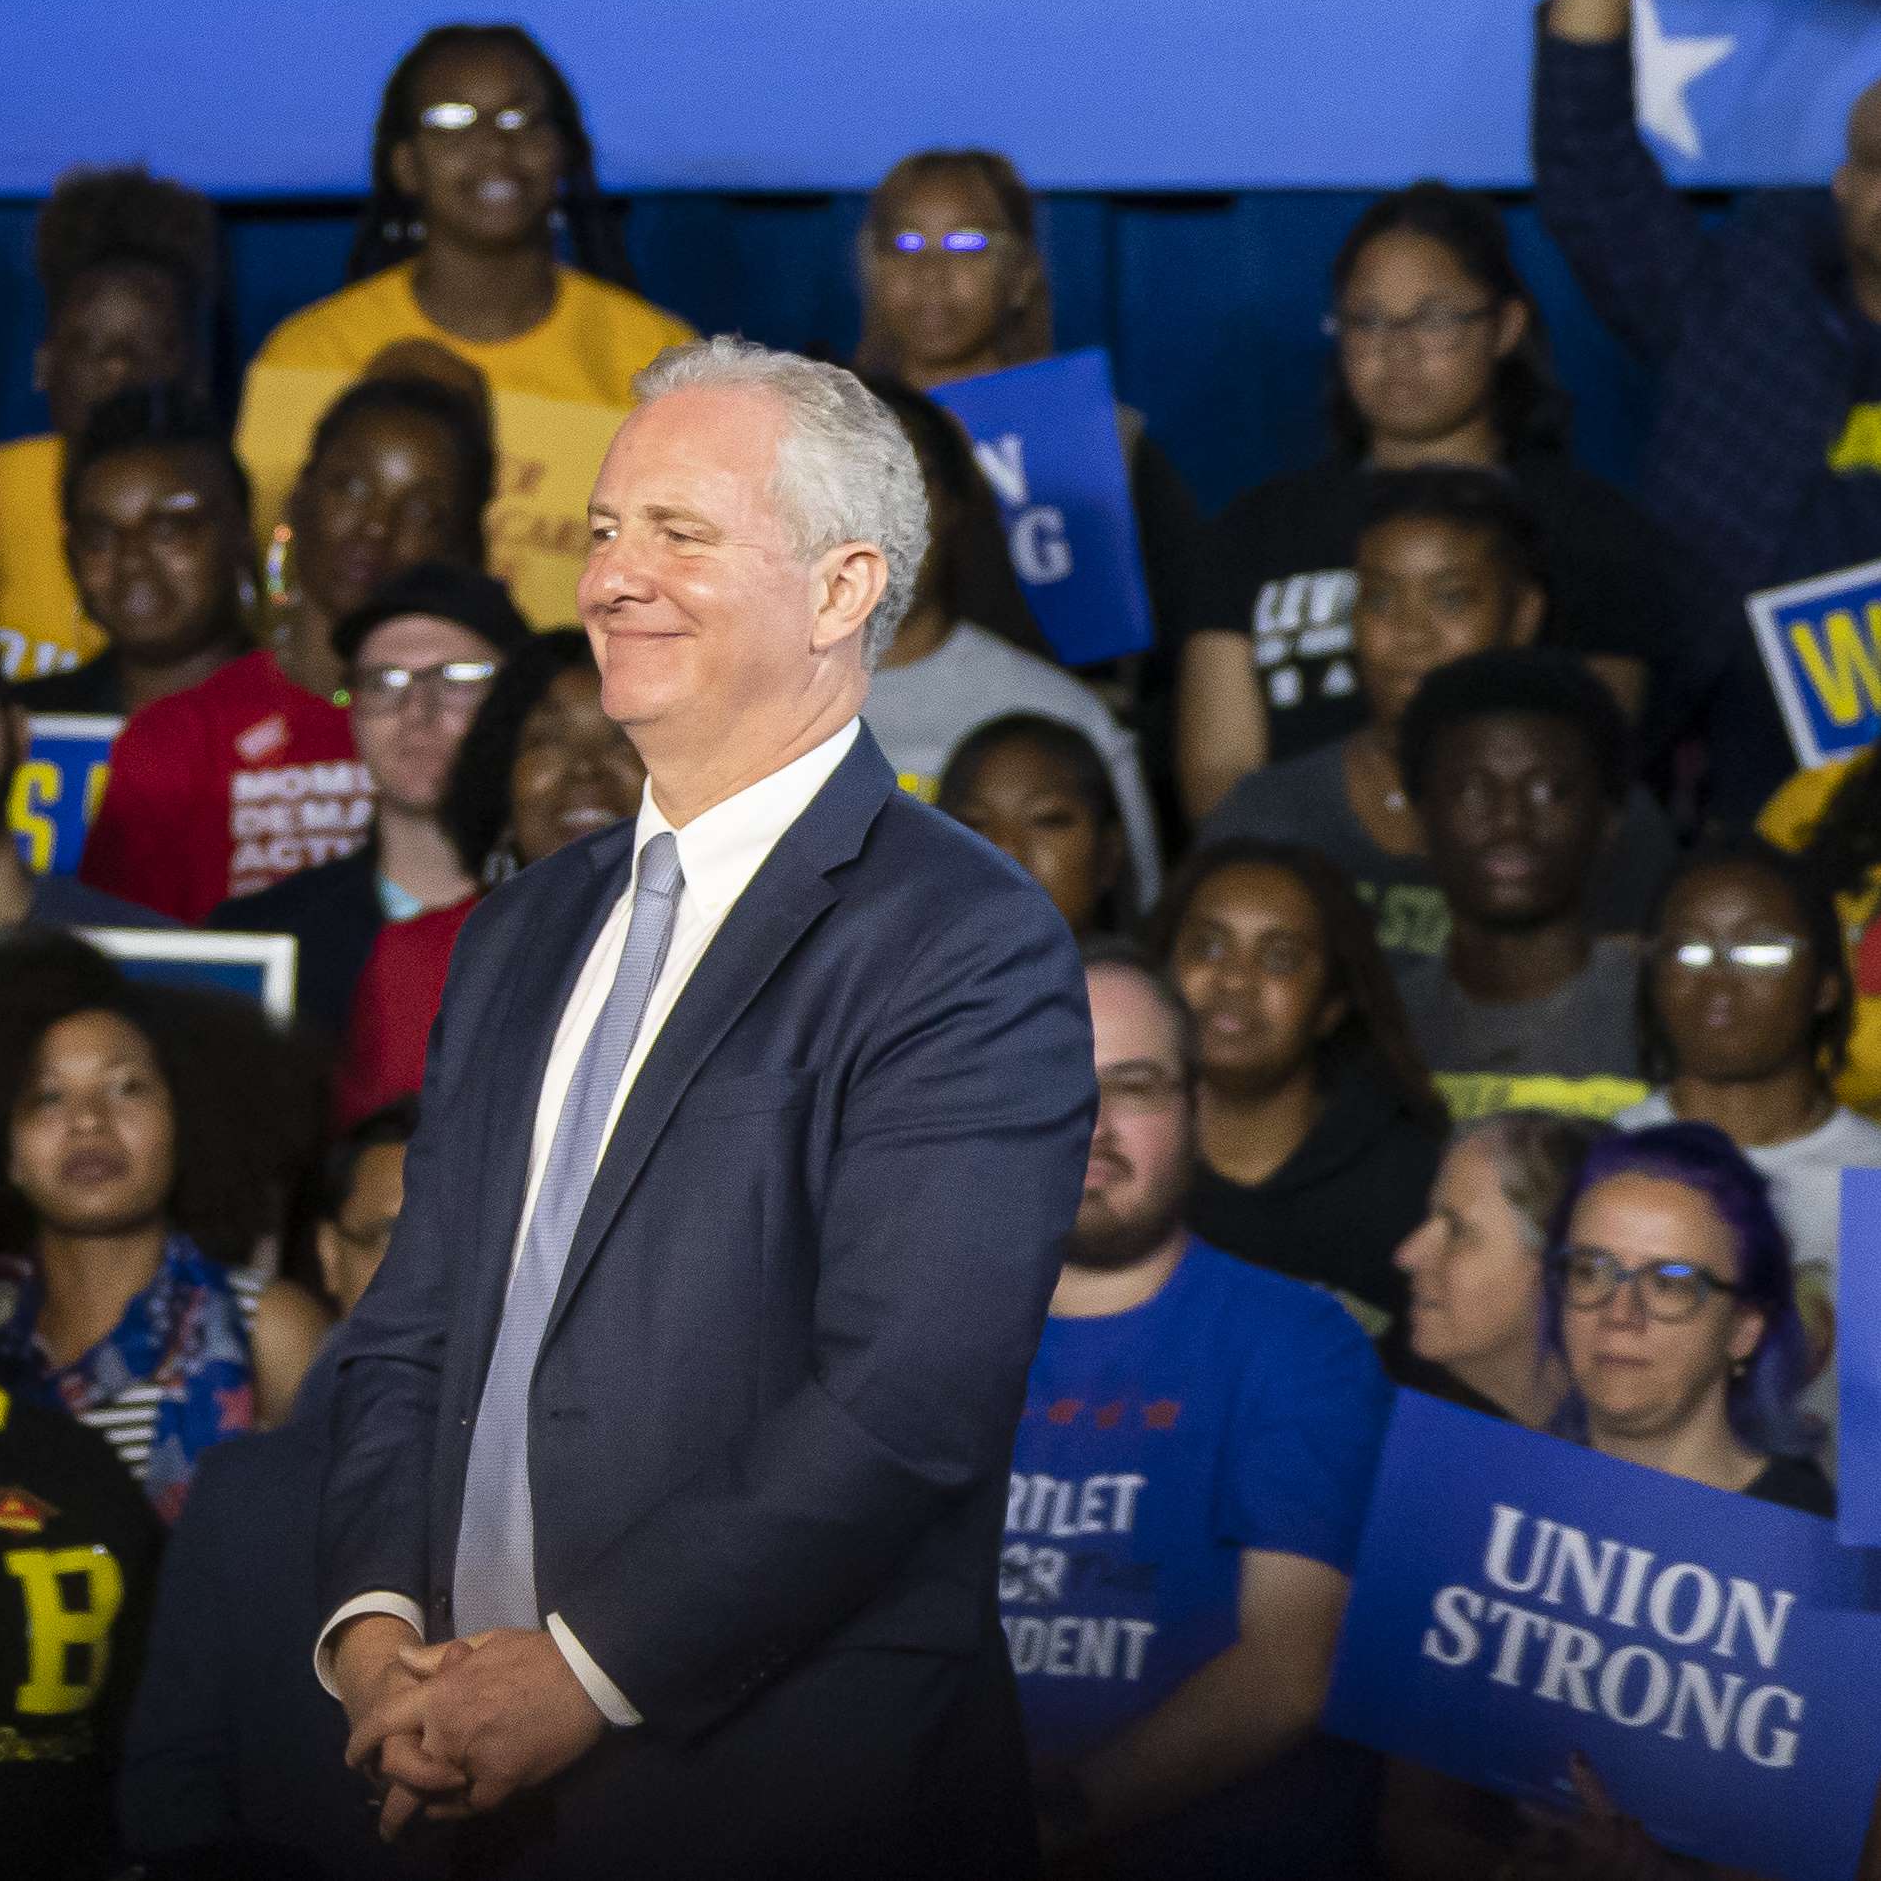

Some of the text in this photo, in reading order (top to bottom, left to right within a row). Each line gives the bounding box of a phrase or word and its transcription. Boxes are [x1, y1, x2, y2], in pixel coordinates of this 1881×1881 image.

[1, 1544, 127, 1716] B
[1483, 1502, 1799, 1672] UNION
[1419, 1584, 1807, 1772] STRONG
